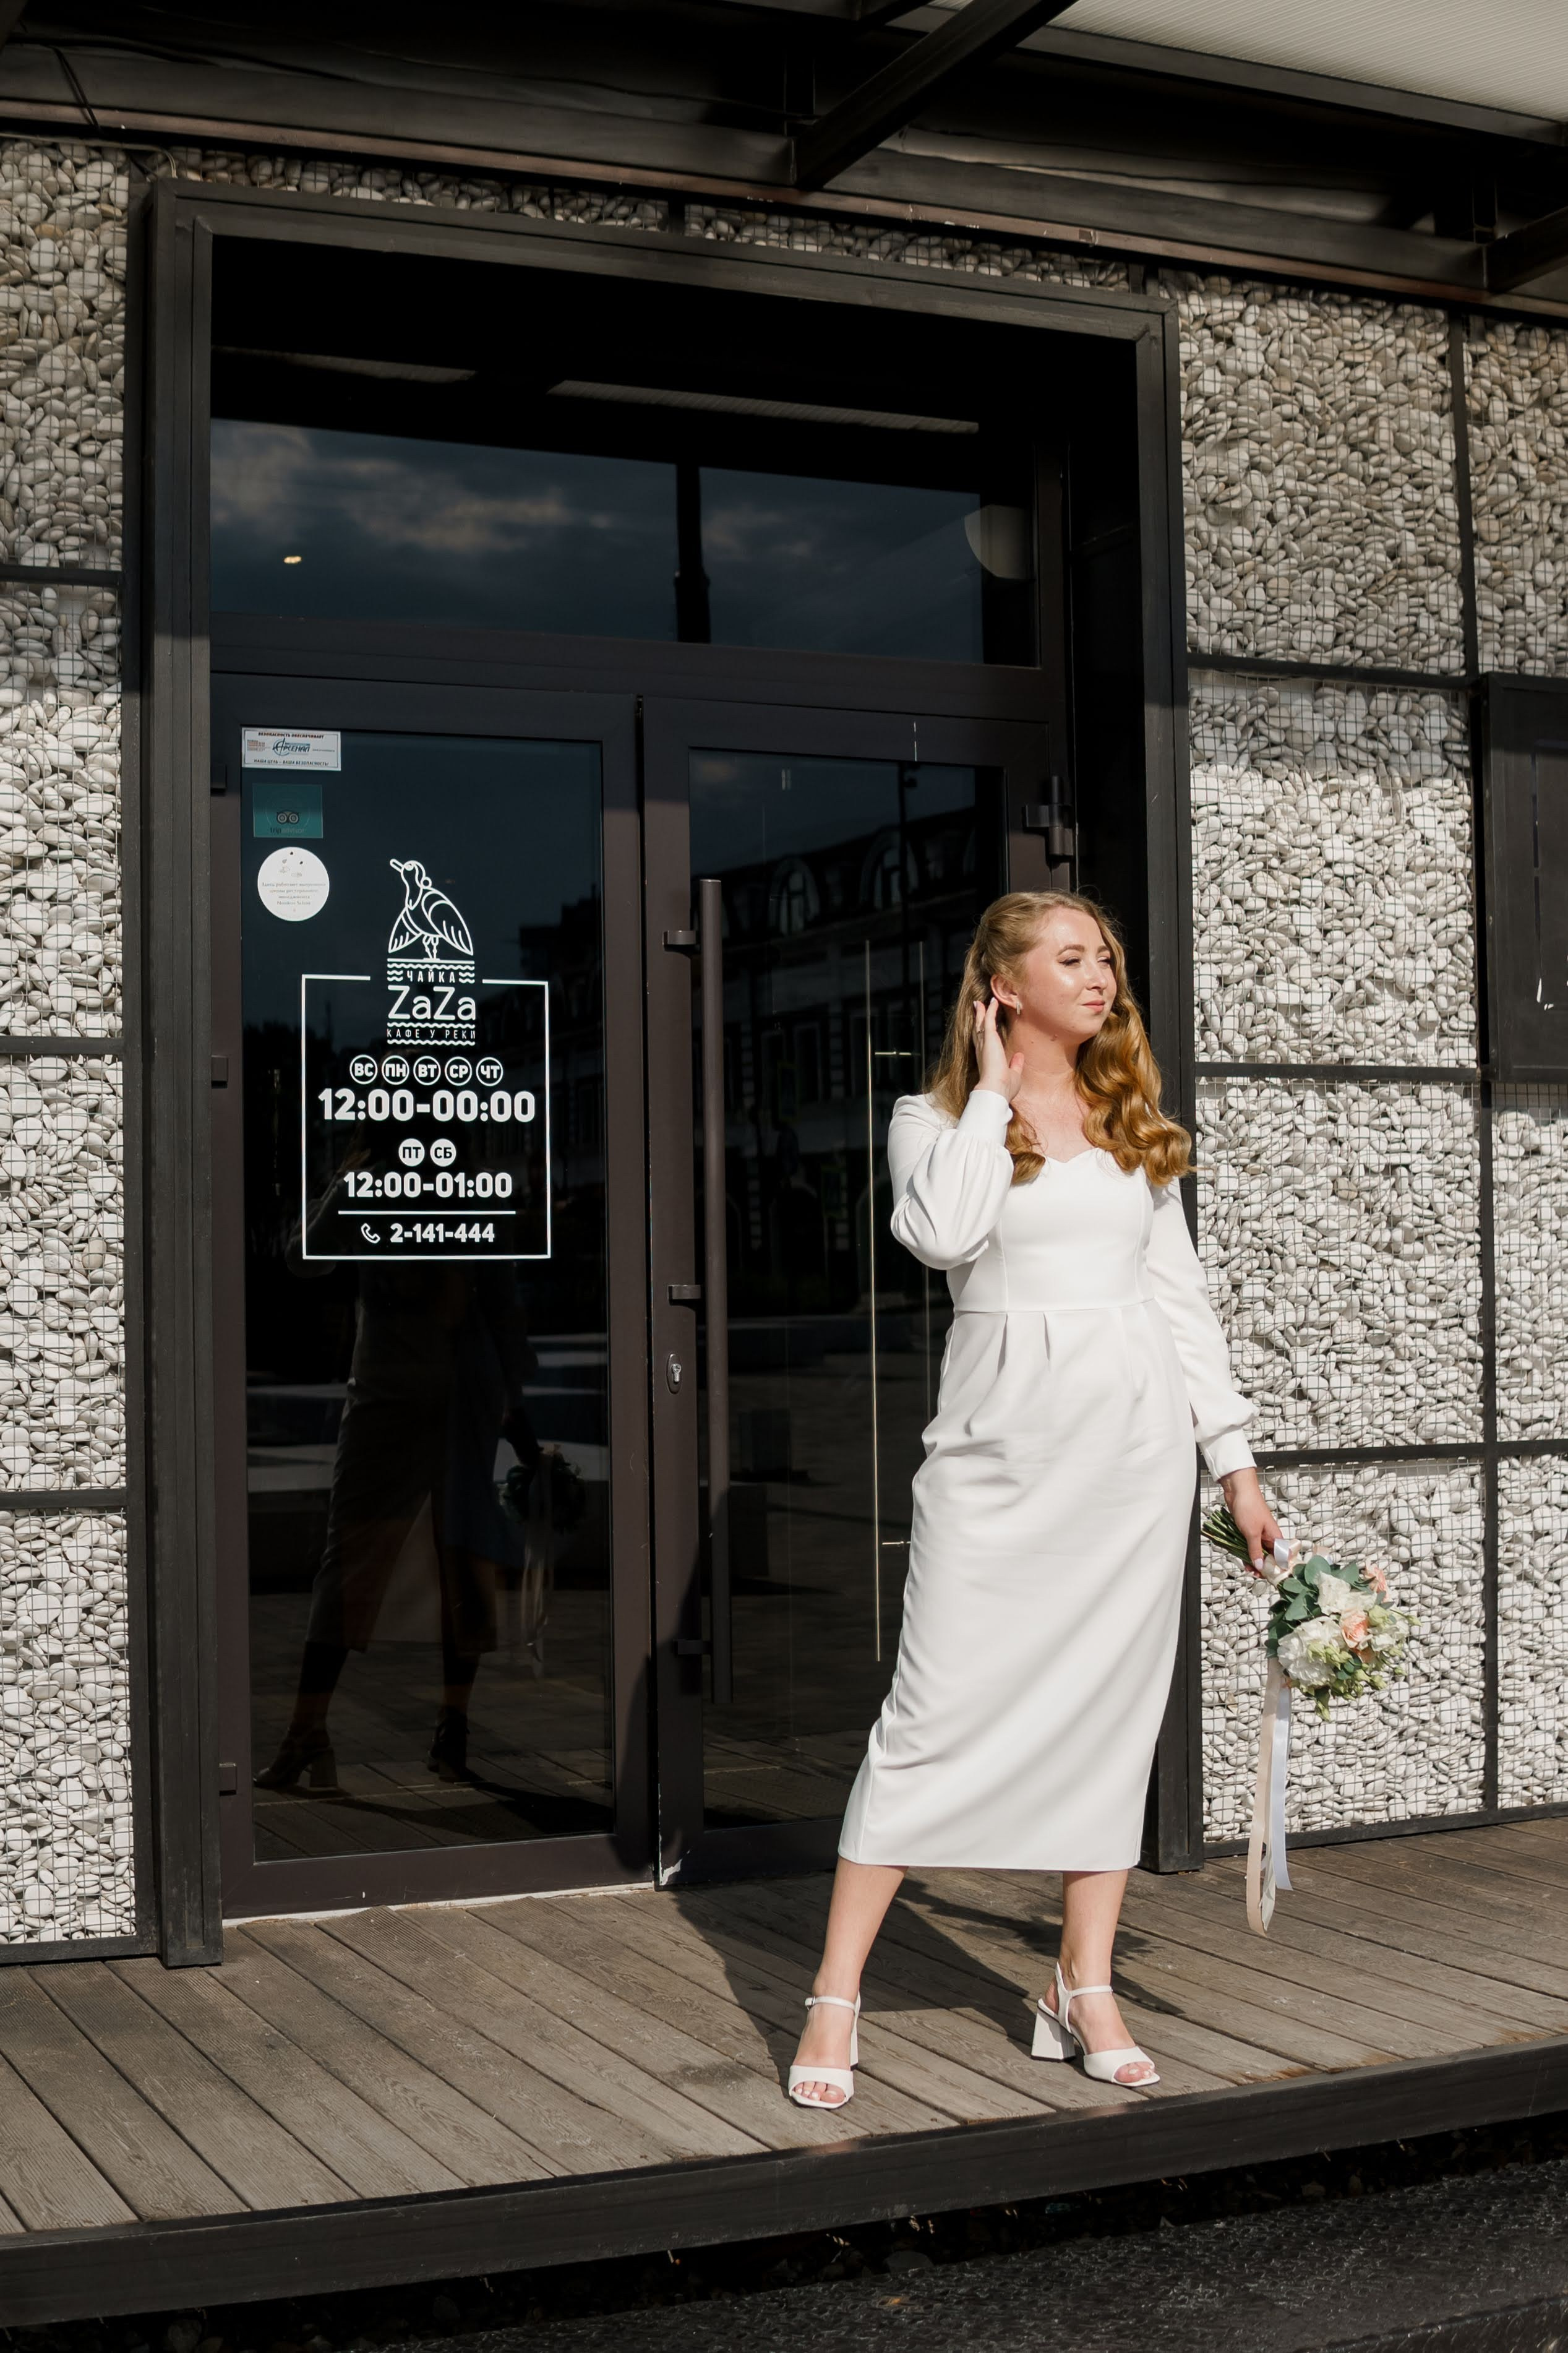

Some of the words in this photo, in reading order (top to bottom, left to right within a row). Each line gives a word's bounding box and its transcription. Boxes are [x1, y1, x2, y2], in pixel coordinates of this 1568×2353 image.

[406, 969, 455, 983] ЧАЙКА
[387, 984, 476, 1021] ZaZa
[387, 1028, 420, 1038] КАФЕ
[430, 1029, 435, 1038] У
[445, 1030, 476, 1039] РЕКИ
[354, 1062, 374, 1077] ВС
[385, 1063, 406, 1077] ПН
[418, 1064, 437, 1078] ВТ
[449, 1064, 468, 1078] СР
[481, 1065, 500, 1079] ЧТ
[318, 1088, 536, 1122] 12:00-00:00
[402, 1146, 421, 1159] ПТ
[434, 1146, 453, 1159] СБ
[343, 1171, 512, 1198] 12:00-01:00
[390, 1223, 495, 1243] 2-141-444
